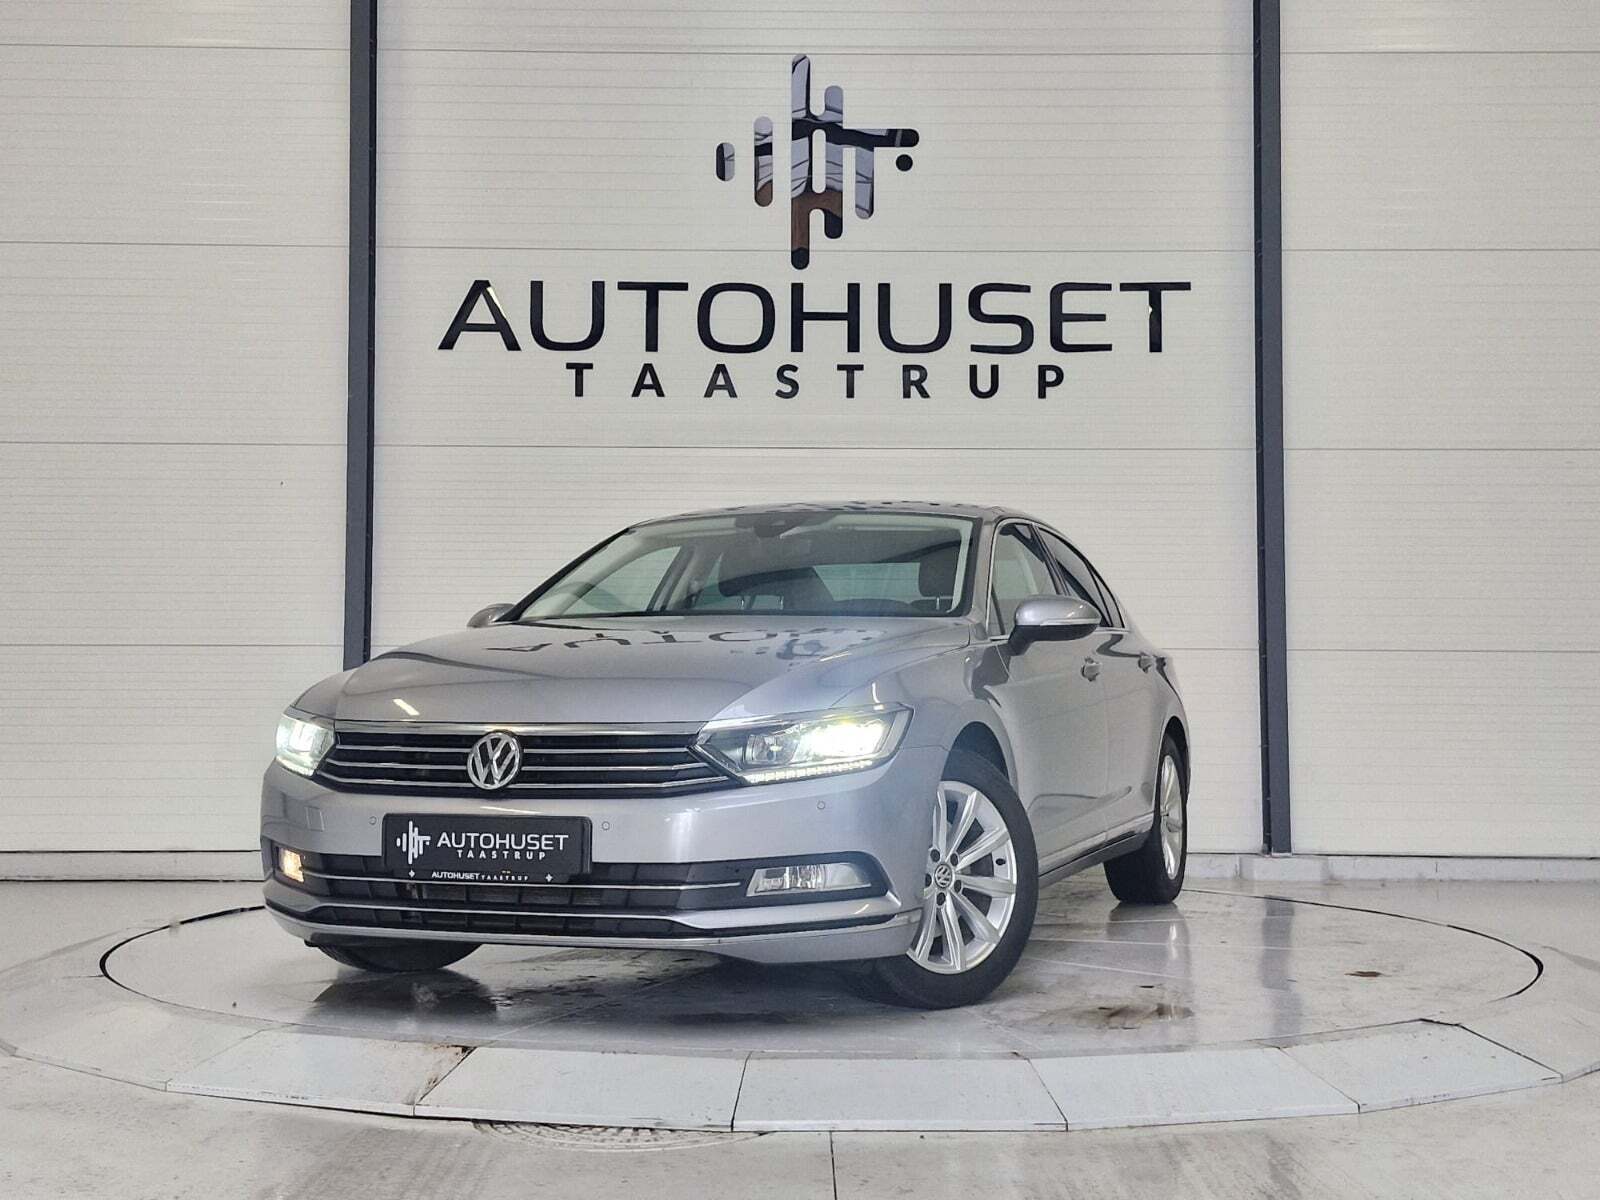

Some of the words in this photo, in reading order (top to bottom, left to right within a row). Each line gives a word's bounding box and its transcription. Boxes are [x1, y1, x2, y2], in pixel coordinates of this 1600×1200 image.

[438, 280, 1192, 354] AUTOHUSET
[566, 363, 1065, 400] TAASTRUP
[468, 733, 519, 788] VW
[436, 832, 569, 851] AUTOHUSET
[457, 849, 546, 861] TAASTRUP
[431, 871, 480, 880] AUTOHUSET
